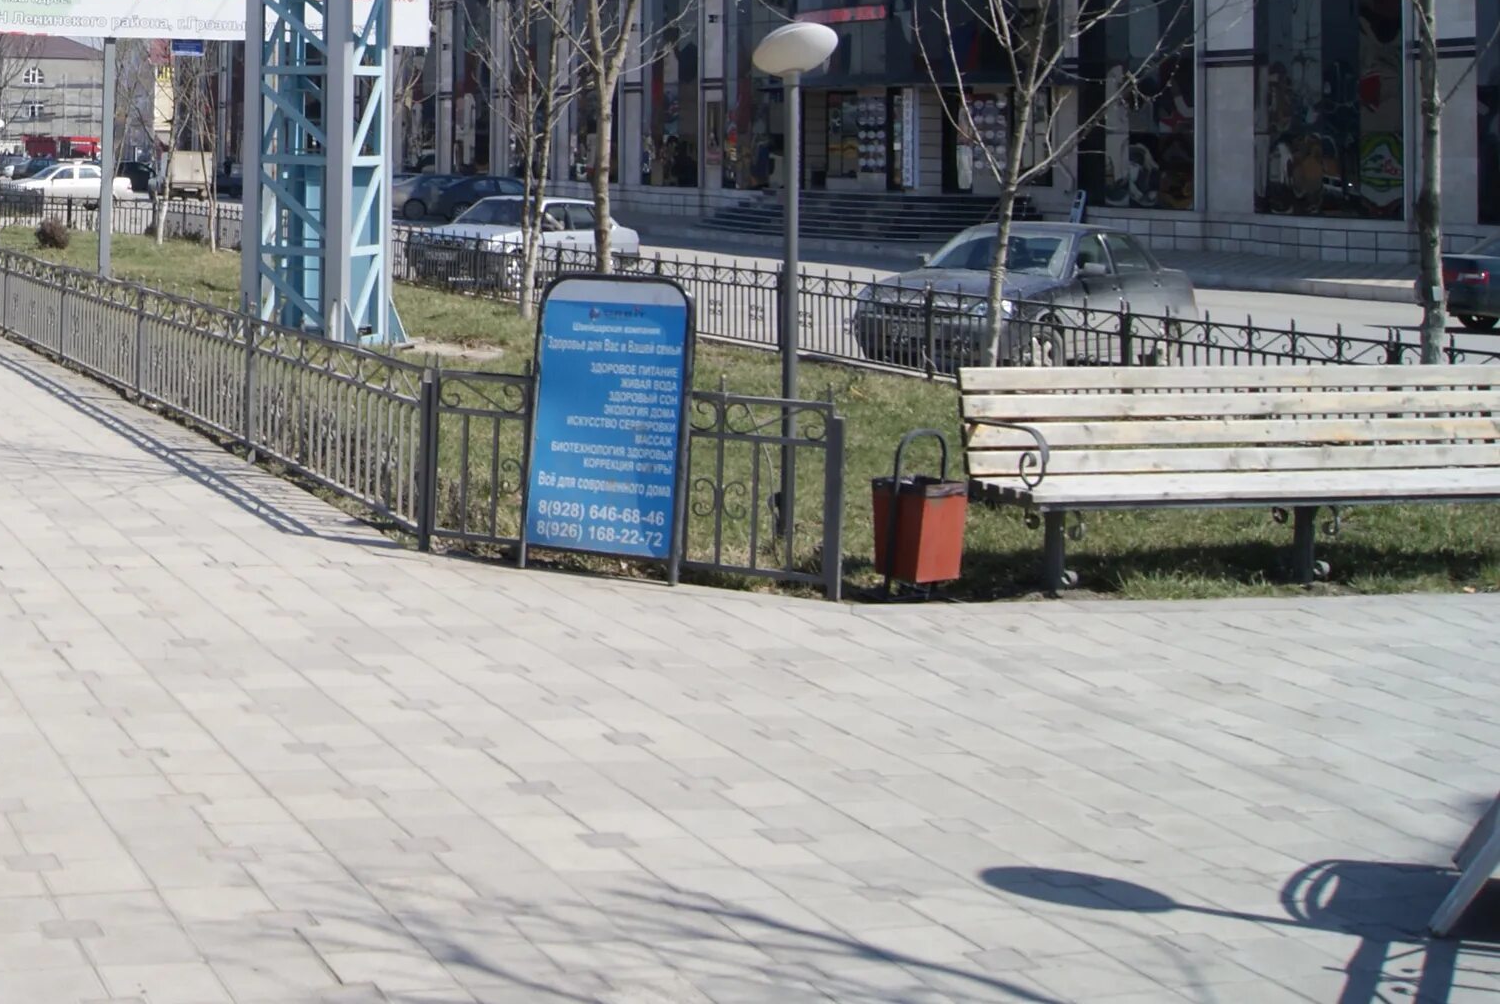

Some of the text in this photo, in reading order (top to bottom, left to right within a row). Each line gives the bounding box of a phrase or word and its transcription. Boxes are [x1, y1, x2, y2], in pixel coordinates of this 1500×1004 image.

[12, 11, 106, 28] Ленинского
[590, 362, 678, 378] ЗДОРОВОЕ ПИТАНИЕ
[620, 378, 678, 392] ЖИВАЯ ВОДА
[659, 394, 678, 406] СОН
[650, 407, 676, 419] ДОМА
[566, 415, 618, 429] ИСКУССТВО
[635, 434, 673, 446] МАССАЖ
[583, 457, 634, 472] КОРРЕКЦИЯ
[645, 484, 671, 499] дома
[538, 499, 665, 527] 8(928) 646-68-46
[536, 520, 663, 548] 8(926) 168-22-72
